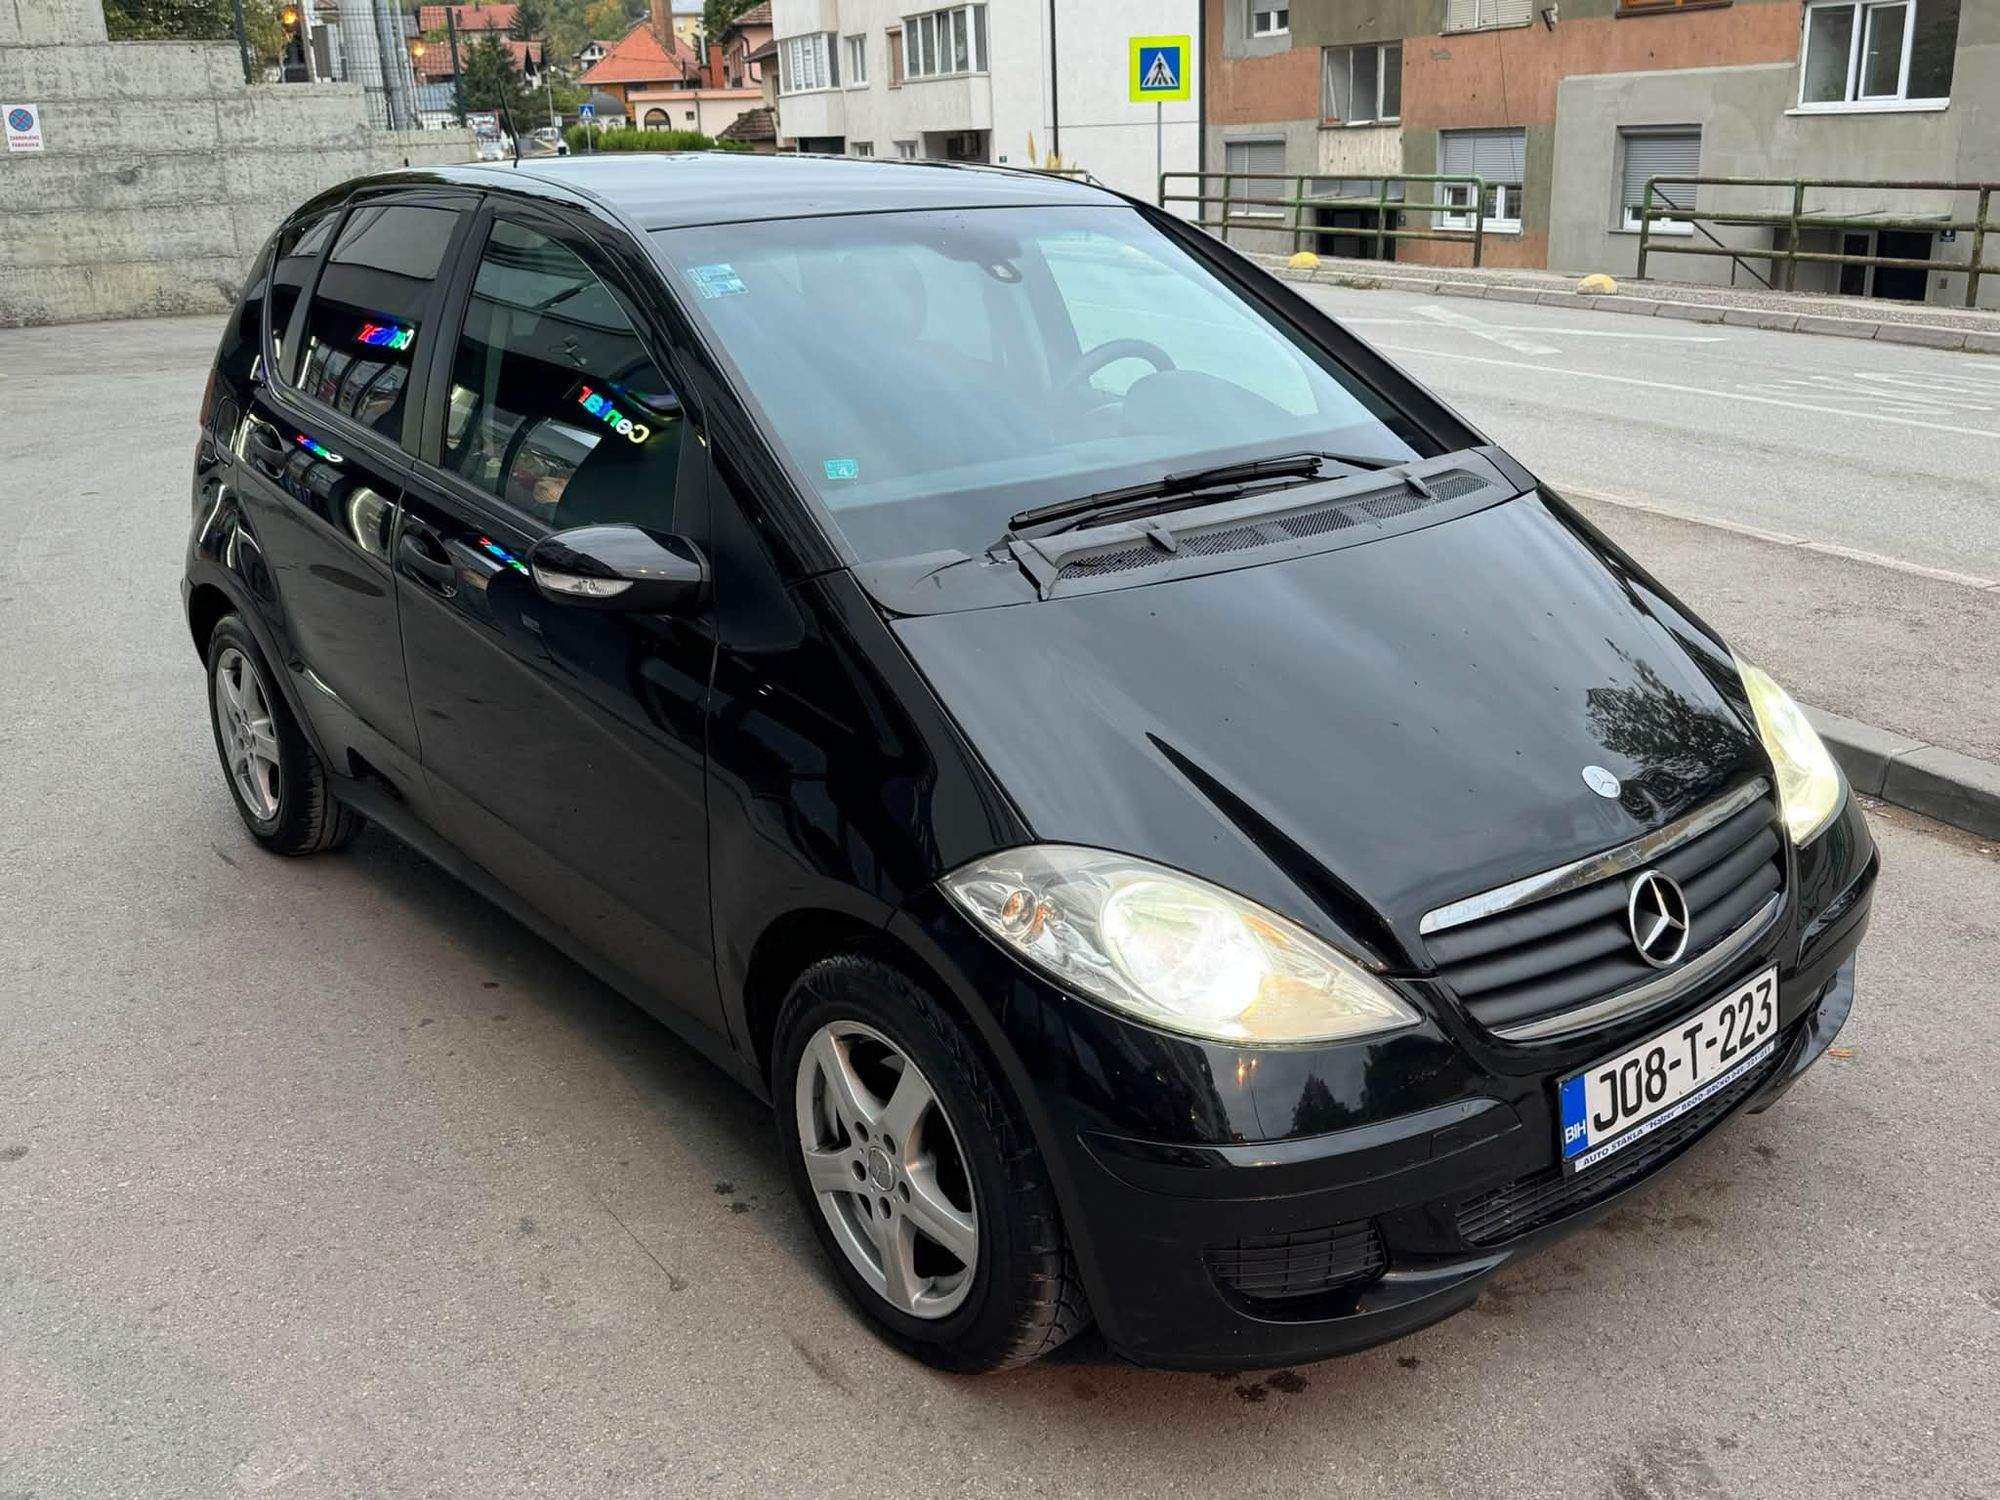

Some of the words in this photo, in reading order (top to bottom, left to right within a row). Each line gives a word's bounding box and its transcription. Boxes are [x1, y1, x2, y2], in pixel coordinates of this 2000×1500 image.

[1593, 978, 1772, 1132] J08-T-223
[1565, 1120, 1587, 1144] BIH
[1583, 1148, 1609, 1165] AUTO
